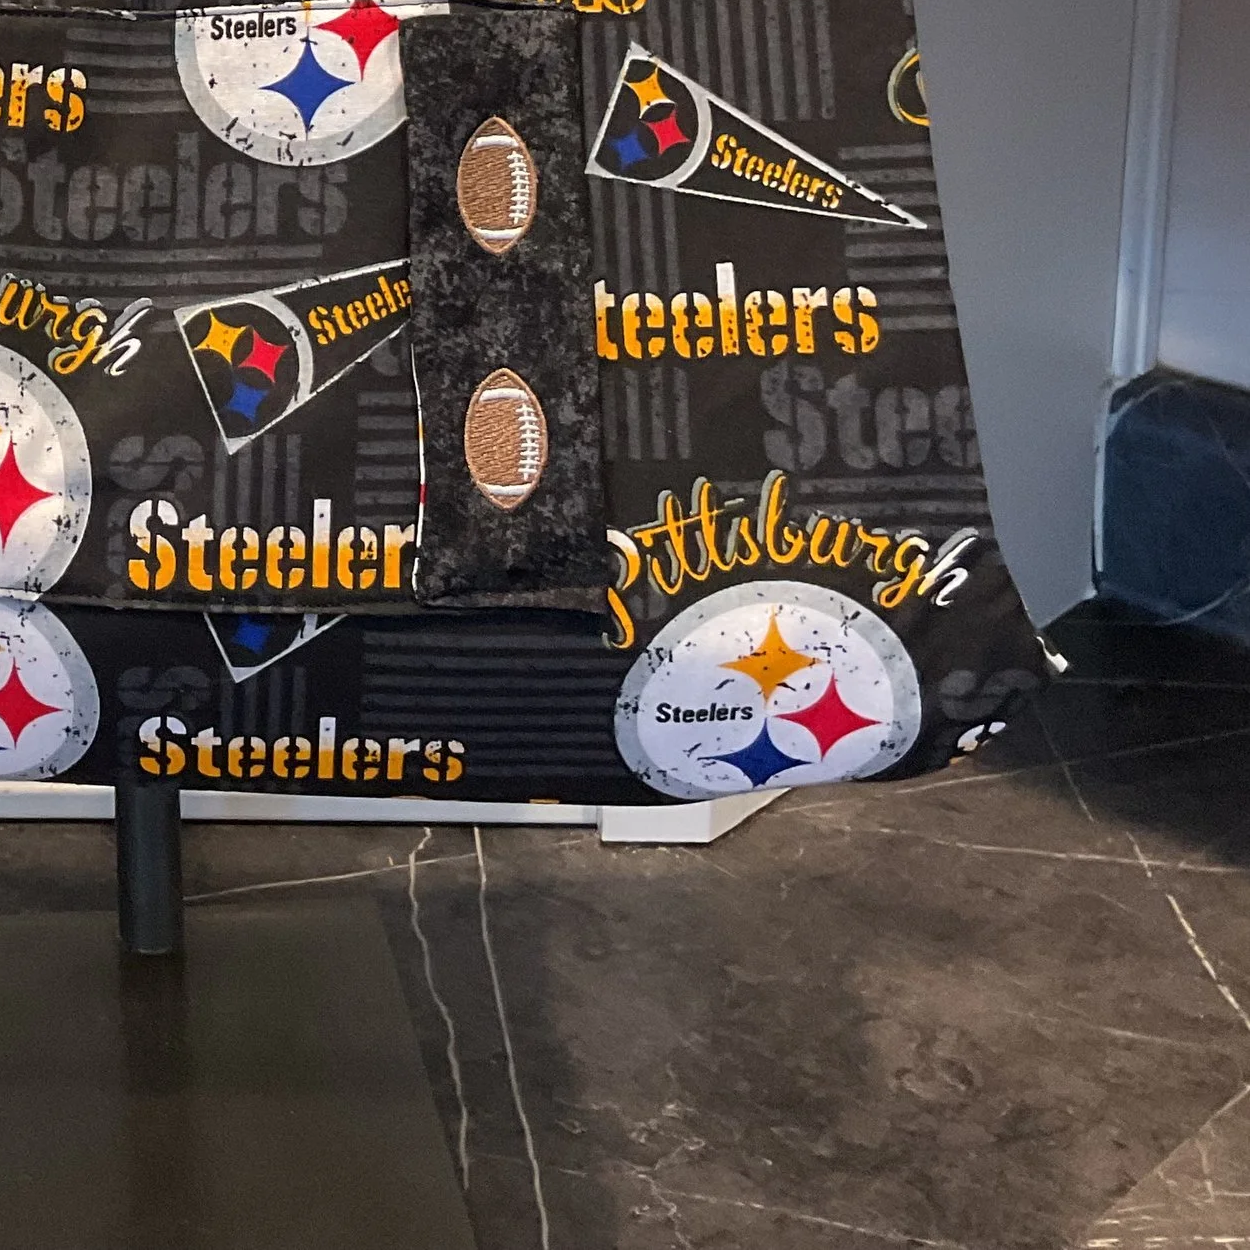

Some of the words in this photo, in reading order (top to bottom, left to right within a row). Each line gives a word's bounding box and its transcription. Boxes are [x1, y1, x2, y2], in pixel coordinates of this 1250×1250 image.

[210, 13, 297, 41] Steelers
[711, 133, 844, 209] Steelers
[593, 262, 880, 361] teelers
[128, 498, 416, 592] Steeler
[656, 702, 754, 723] Steelers
[138, 716, 466, 782] Steelers
